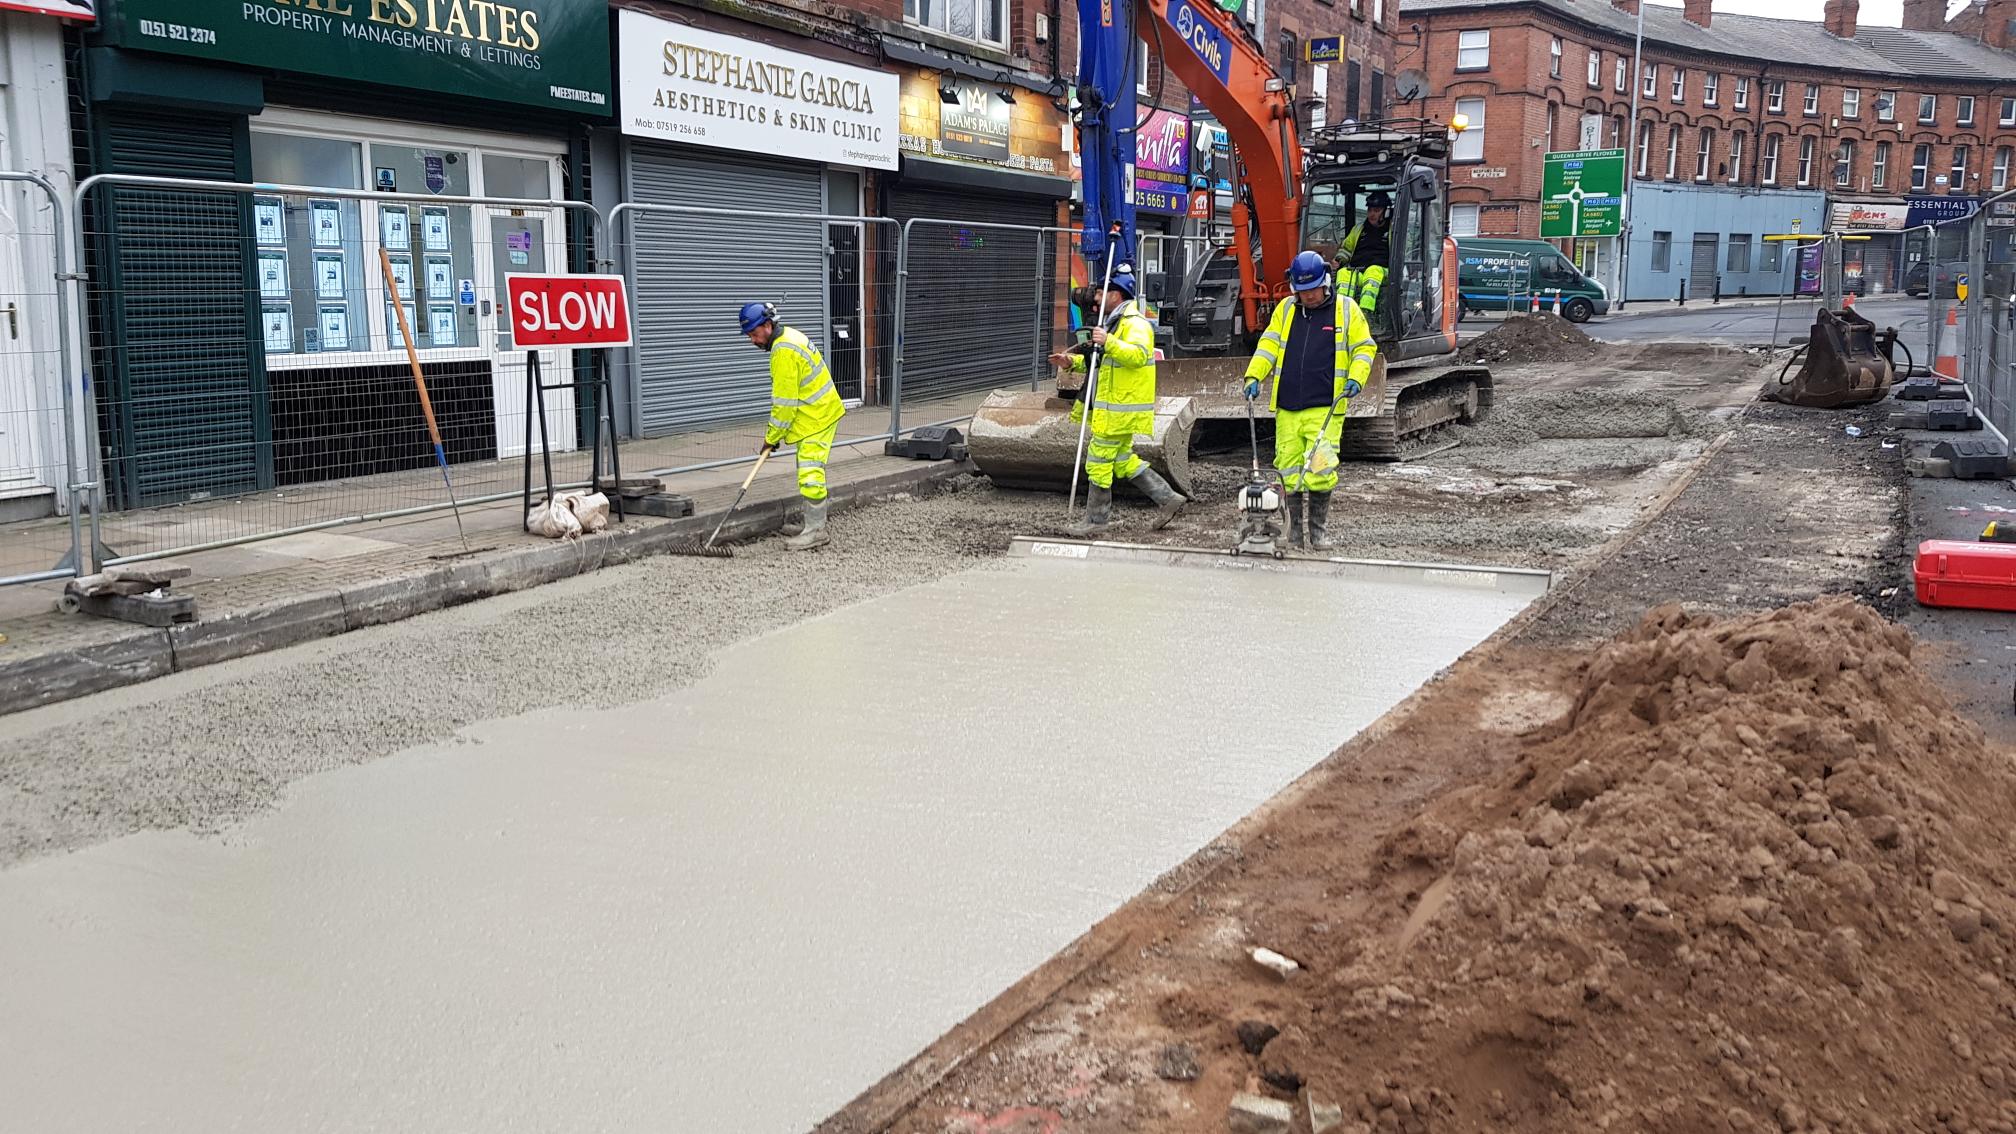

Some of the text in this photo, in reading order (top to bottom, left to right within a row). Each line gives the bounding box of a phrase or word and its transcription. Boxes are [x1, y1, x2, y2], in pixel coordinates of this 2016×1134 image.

[140, 19, 216, 45] 0151 521 2374
[243, 3, 332, 34] PROPERTY
[342, 21, 453, 54] MANAGEMENT
[461, 43, 471, 58] &
[480, 46, 541, 70] LETTINGS
[368, 0, 540, 51] ESTATES
[1193, 24, 1222, 71] Civils
[662, 40, 873, 114] STEPHANIE GARCIA
[550, 85, 605, 105] PMEESTATES.COM
[635, 118, 706, 136] Mob: 07519 256 658
[653, 88, 882, 142] AESTHETICS & SKIN CLINIC
[944, 111, 1008, 137] ADAM'S PALACE
[1147, 193, 1165, 208] 6663
[1907, 200, 1965, 210] ESSENTIAL
[1465, 257, 1482, 265] RSM
[519, 290, 616, 332] SLOW
